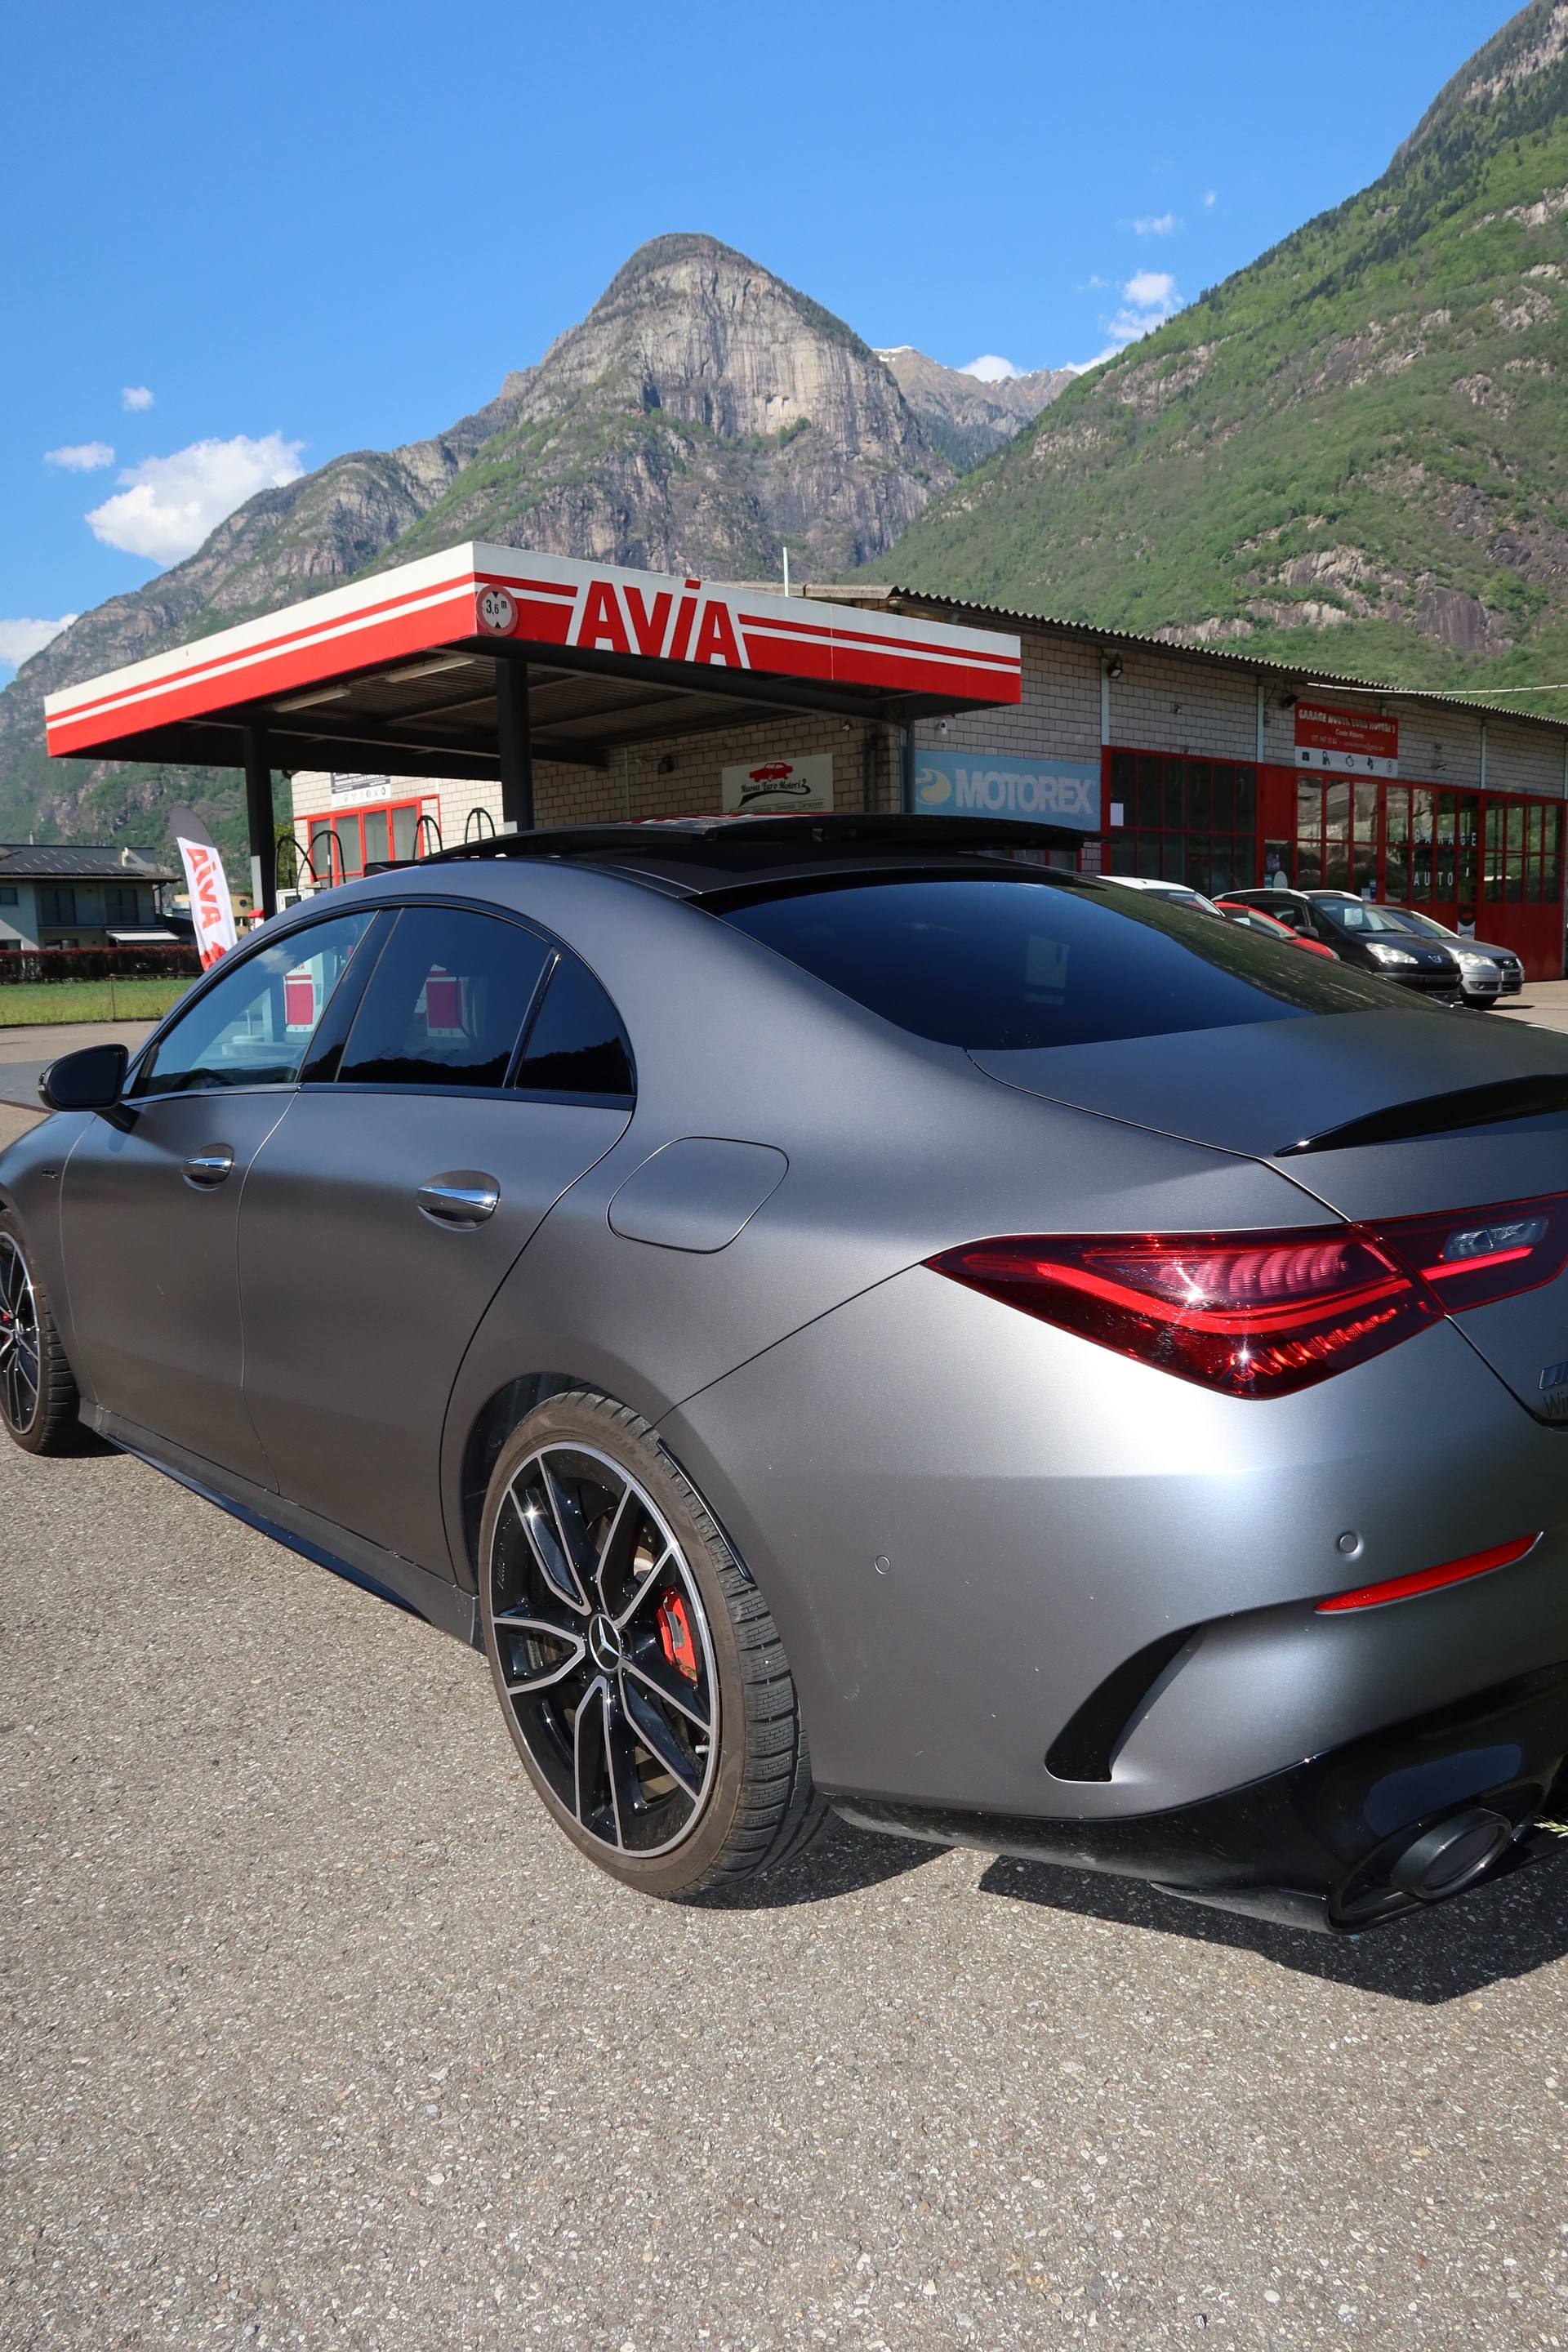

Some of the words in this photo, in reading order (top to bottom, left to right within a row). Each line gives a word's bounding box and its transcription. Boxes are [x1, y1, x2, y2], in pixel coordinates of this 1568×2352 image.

[741, 784, 760, 793] Nuova
[762, 782, 777, 791] Euro
[779, 780, 801, 790] Motori
[956, 768, 1094, 815] MOTOREX
[1414, 828, 1477, 847] GARAGE
[1414, 871, 1454, 886] AUTO
